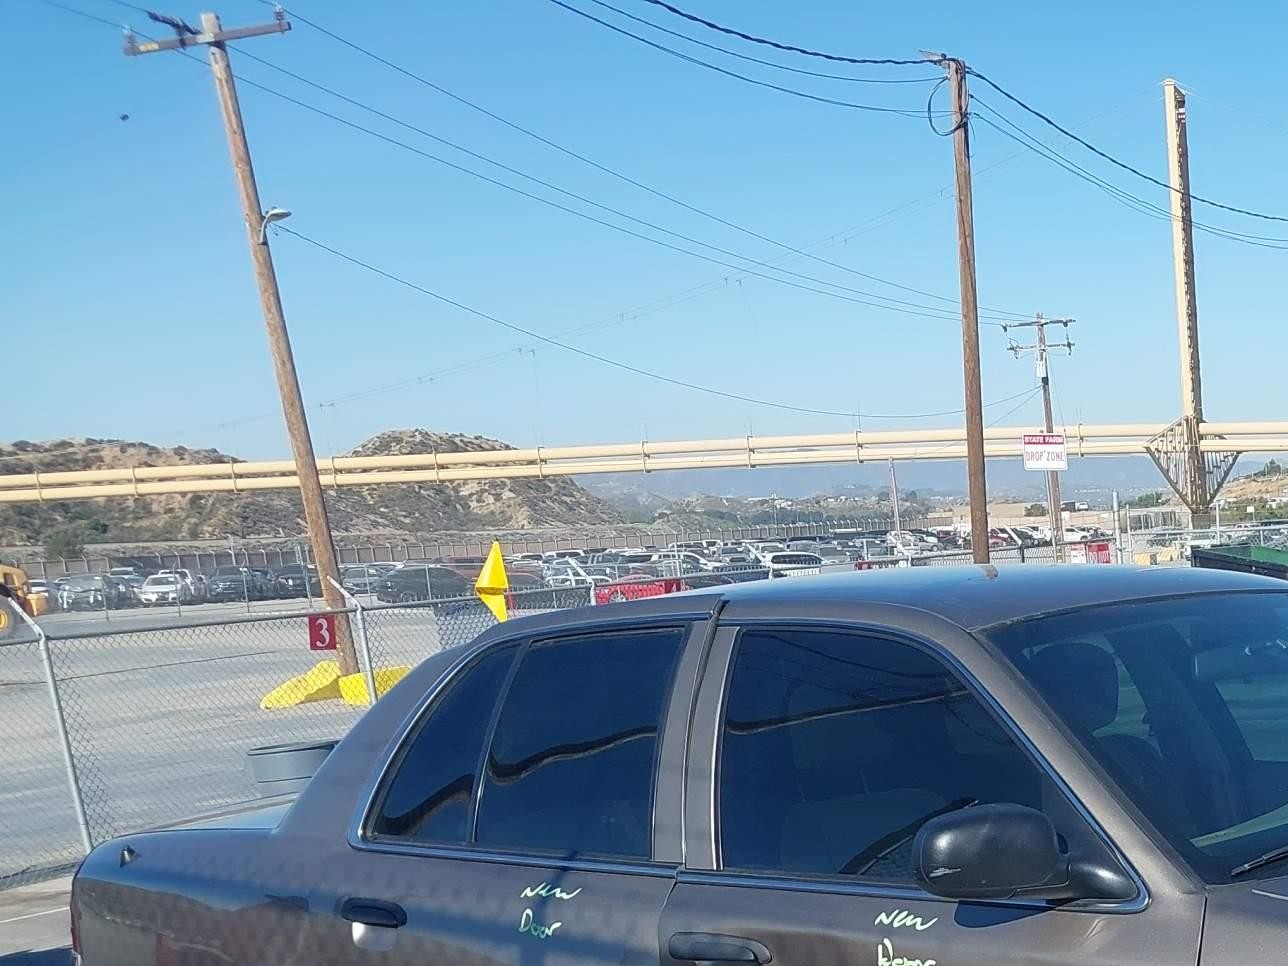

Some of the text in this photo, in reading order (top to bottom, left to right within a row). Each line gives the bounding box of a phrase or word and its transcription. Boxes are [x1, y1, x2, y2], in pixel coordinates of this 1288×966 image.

[1025, 451, 1064, 462] DROP ZONE
[315, 618, 330, 647] 3
[519, 908, 562, 939] Door
